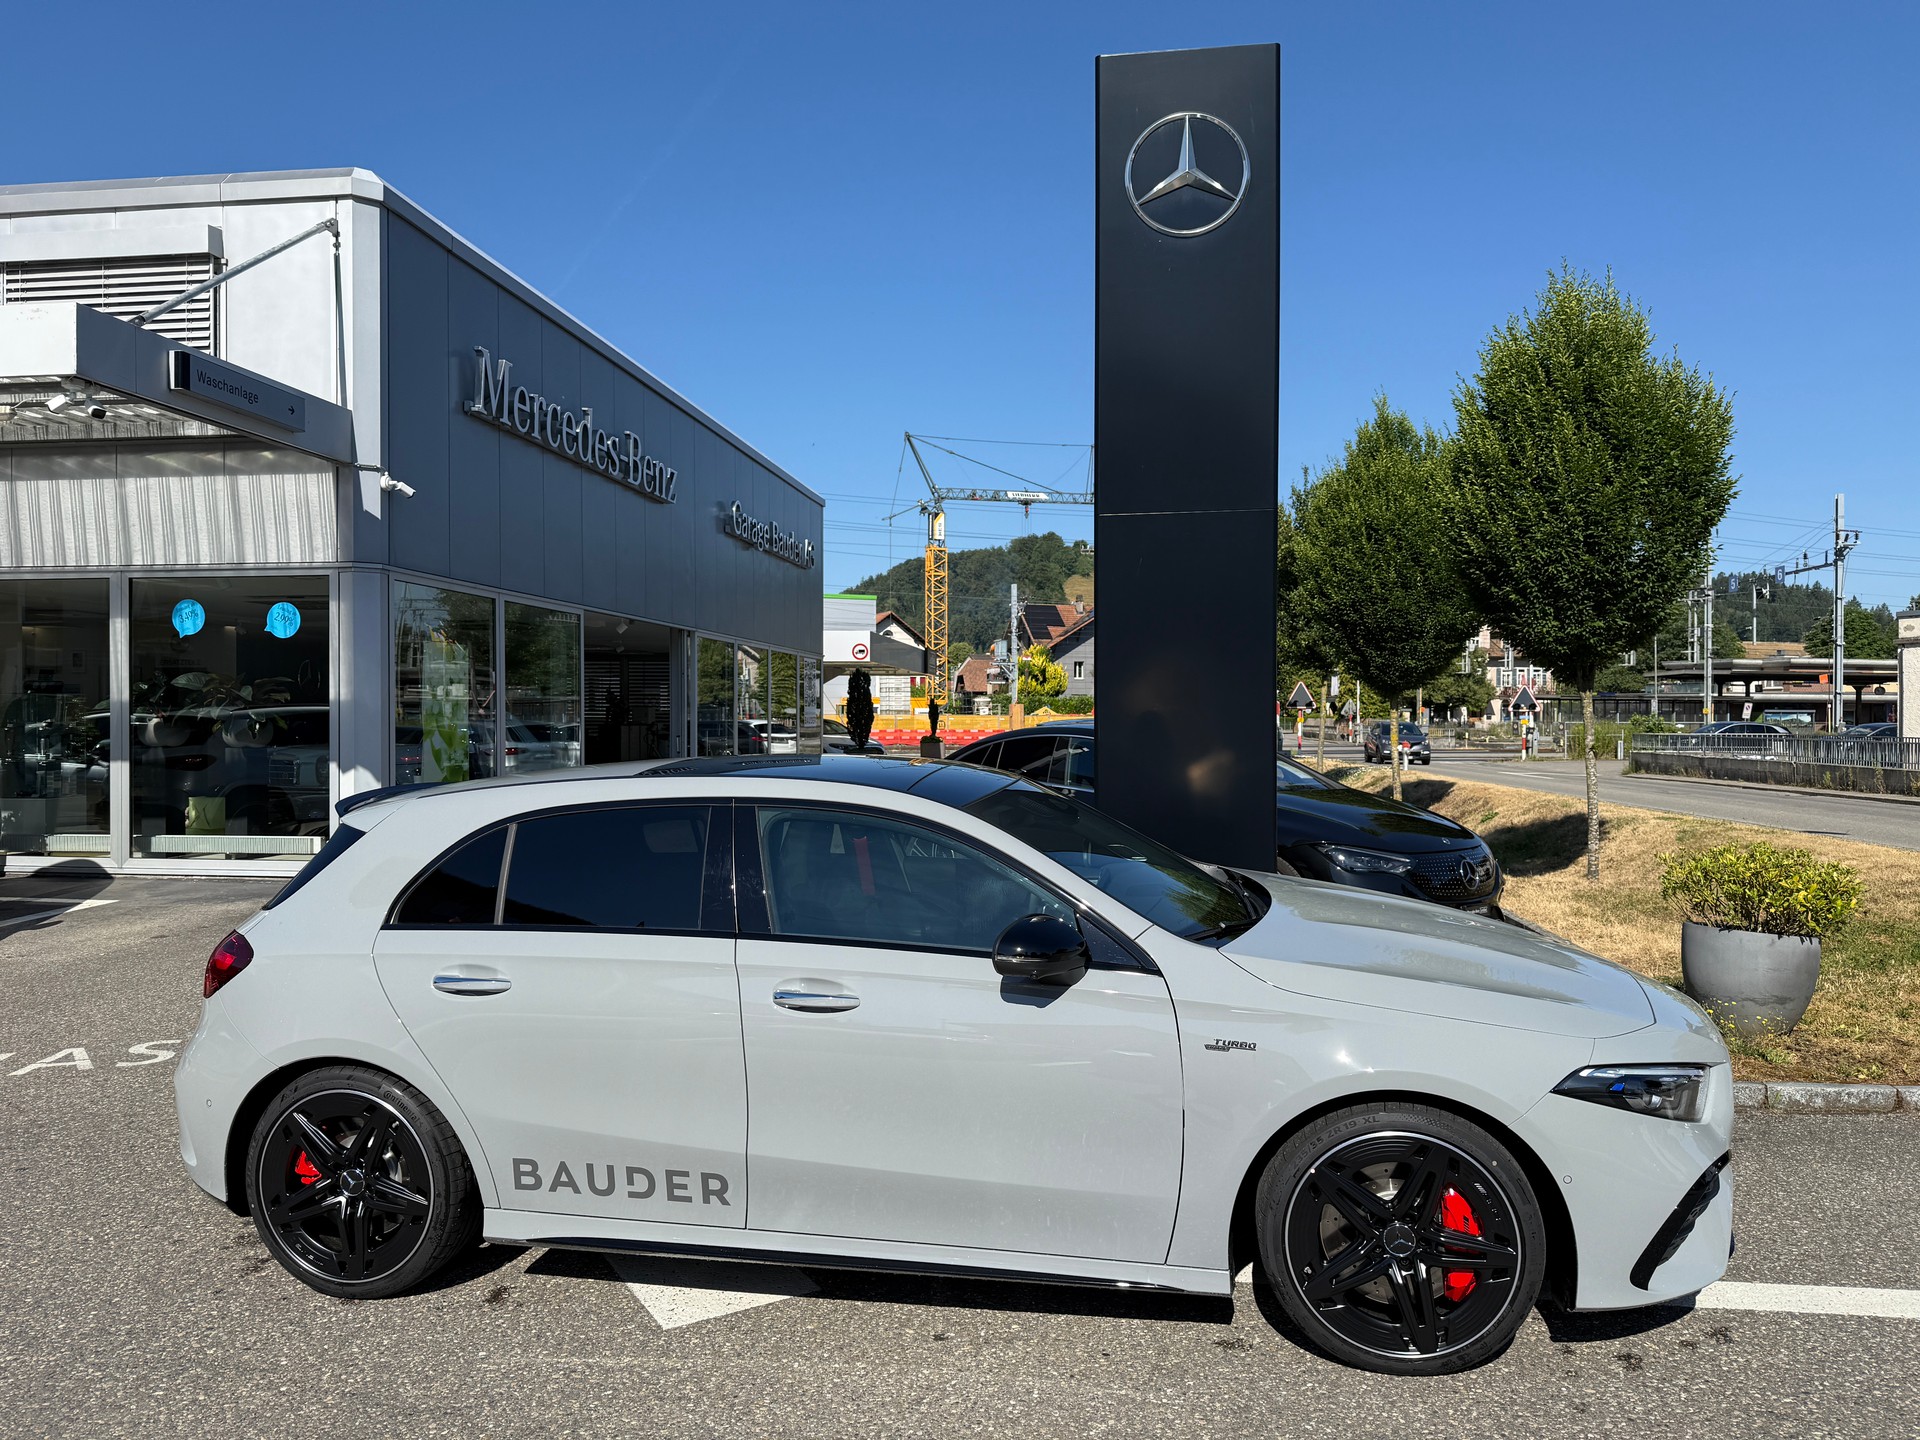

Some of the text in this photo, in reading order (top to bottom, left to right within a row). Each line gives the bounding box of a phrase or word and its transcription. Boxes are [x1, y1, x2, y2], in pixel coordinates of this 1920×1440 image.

[196, 364, 259, 404] Waschanlage
[471, 345, 677, 503] Mercedes-Benz
[732, 500, 770, 551] Garage
[772, 521, 803, 564] Bauder
[1730, 578, 1736, 590] 5
[1777, 569, 1783, 581] 6
[1213, 1038, 1257, 1050] TURBO
[1362, 1115, 1380, 1125] XL
[511, 1157, 732, 1207] BAUDER
